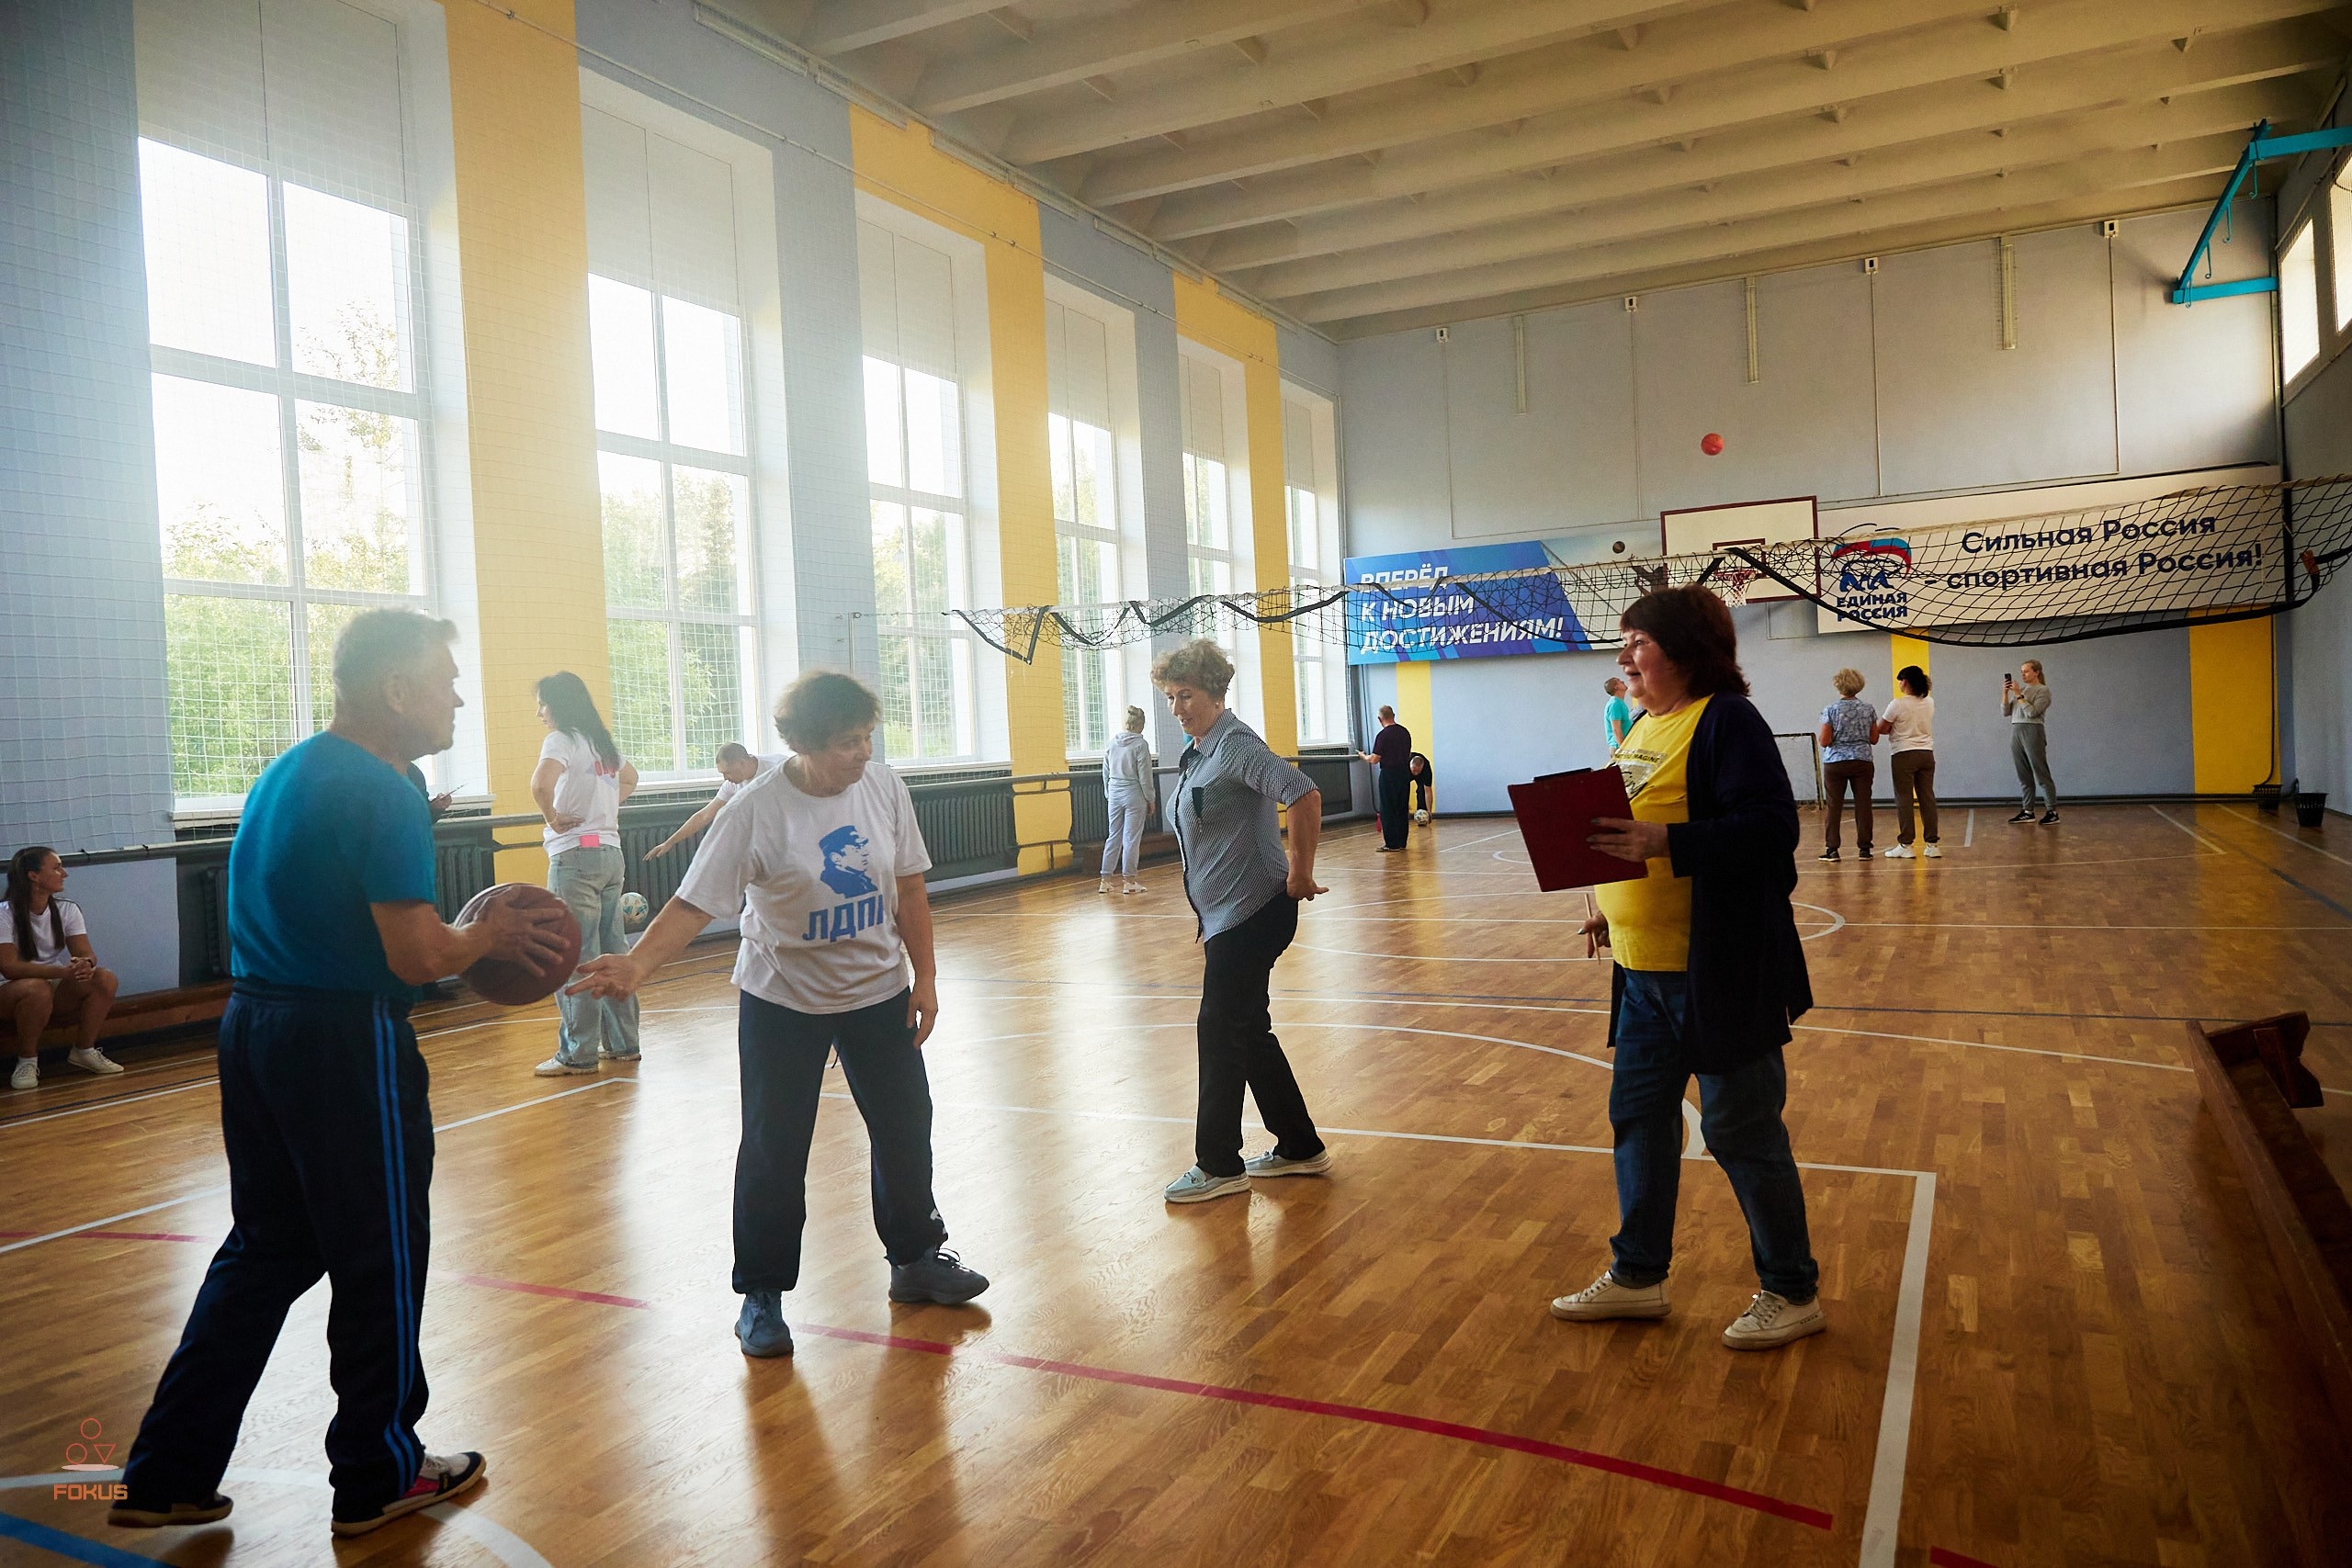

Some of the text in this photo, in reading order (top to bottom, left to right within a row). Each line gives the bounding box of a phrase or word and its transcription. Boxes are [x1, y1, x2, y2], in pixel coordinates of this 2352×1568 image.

[1962, 516, 2216, 554] Сильная Россия
[1361, 563, 1448, 592] ВПЕРЁД
[1947, 558, 2128, 592] спортивная
[2138, 543, 2263, 575] Россия!
[1361, 595, 1473, 623] К НОВЫМ
[1837, 592, 1907, 608] ЕДИНАЯ
[1837, 606, 1908, 622] РОССИЯ
[1361, 616, 1564, 655] ДОСТИЖЕНИЯМ!
